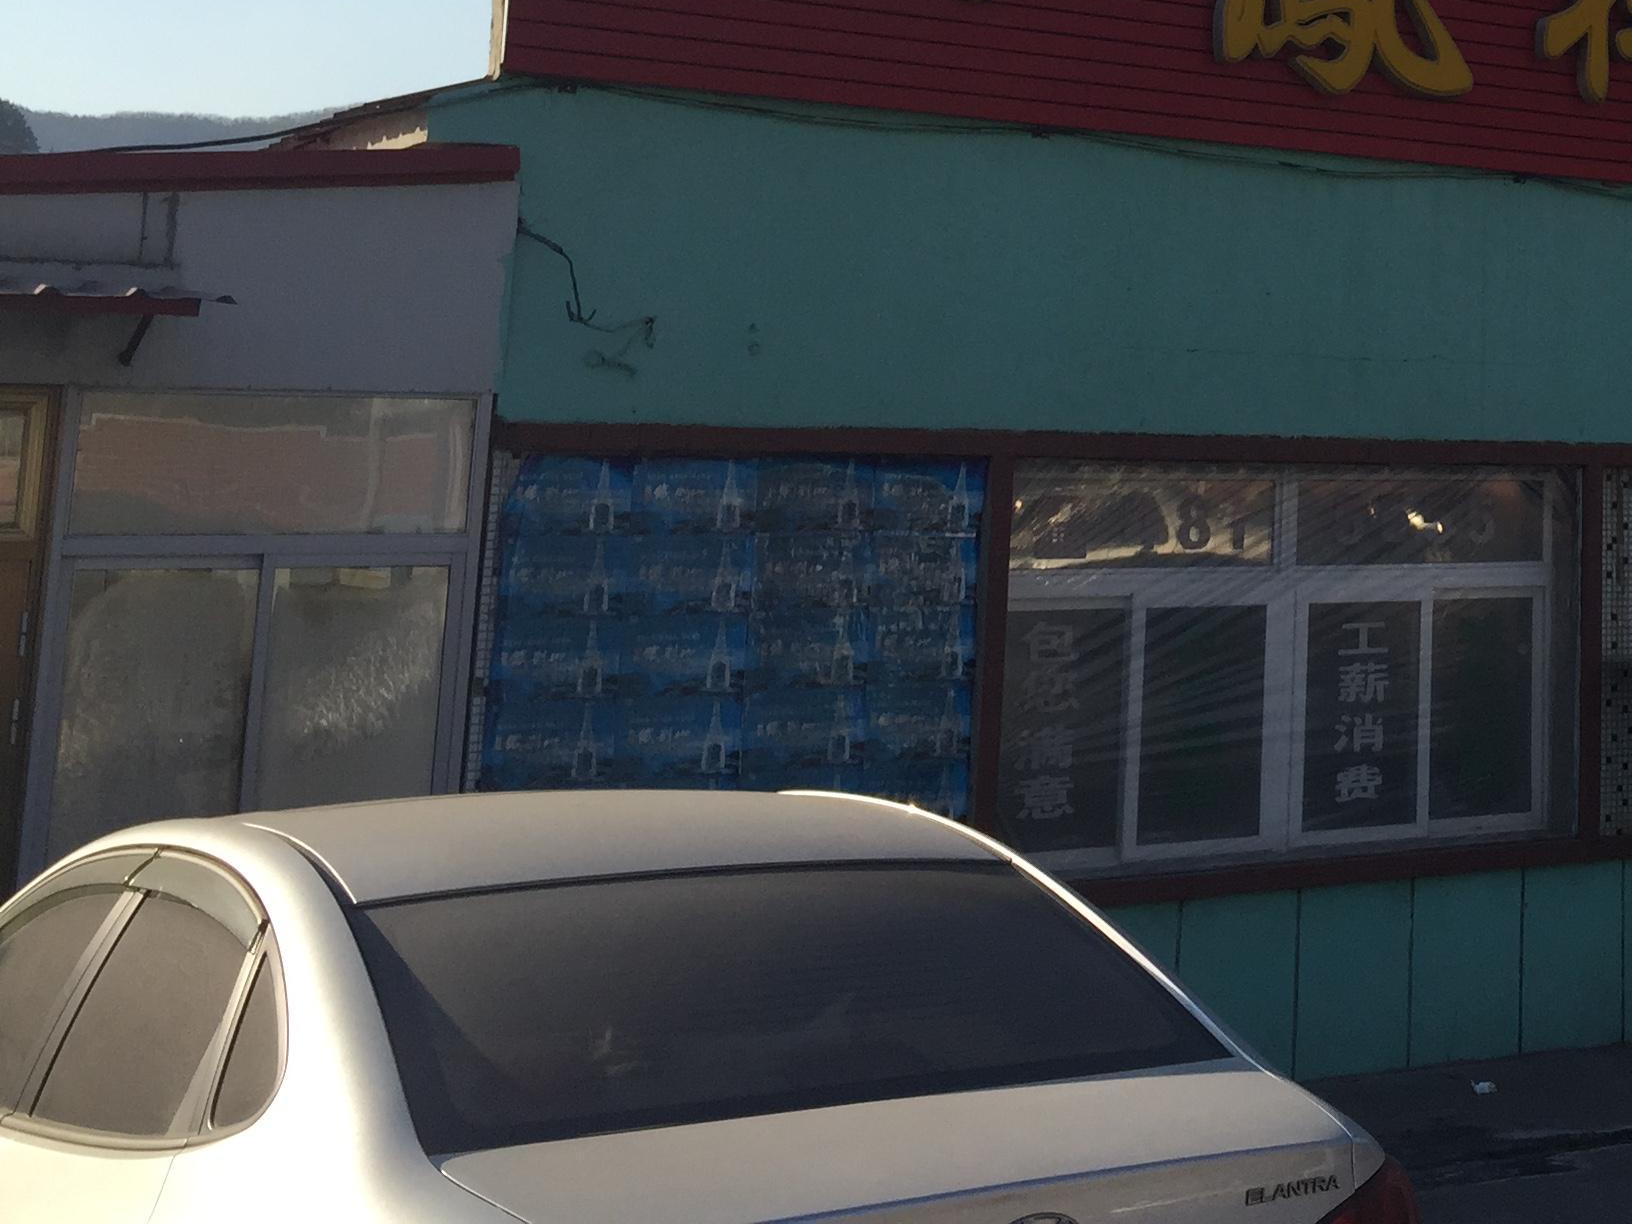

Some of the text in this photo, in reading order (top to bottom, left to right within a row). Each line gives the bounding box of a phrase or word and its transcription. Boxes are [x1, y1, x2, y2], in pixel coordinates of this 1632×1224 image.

[1333, 621, 1390, 804] 工薪消费
[1245, 1175, 1340, 1207] ELANTRA
